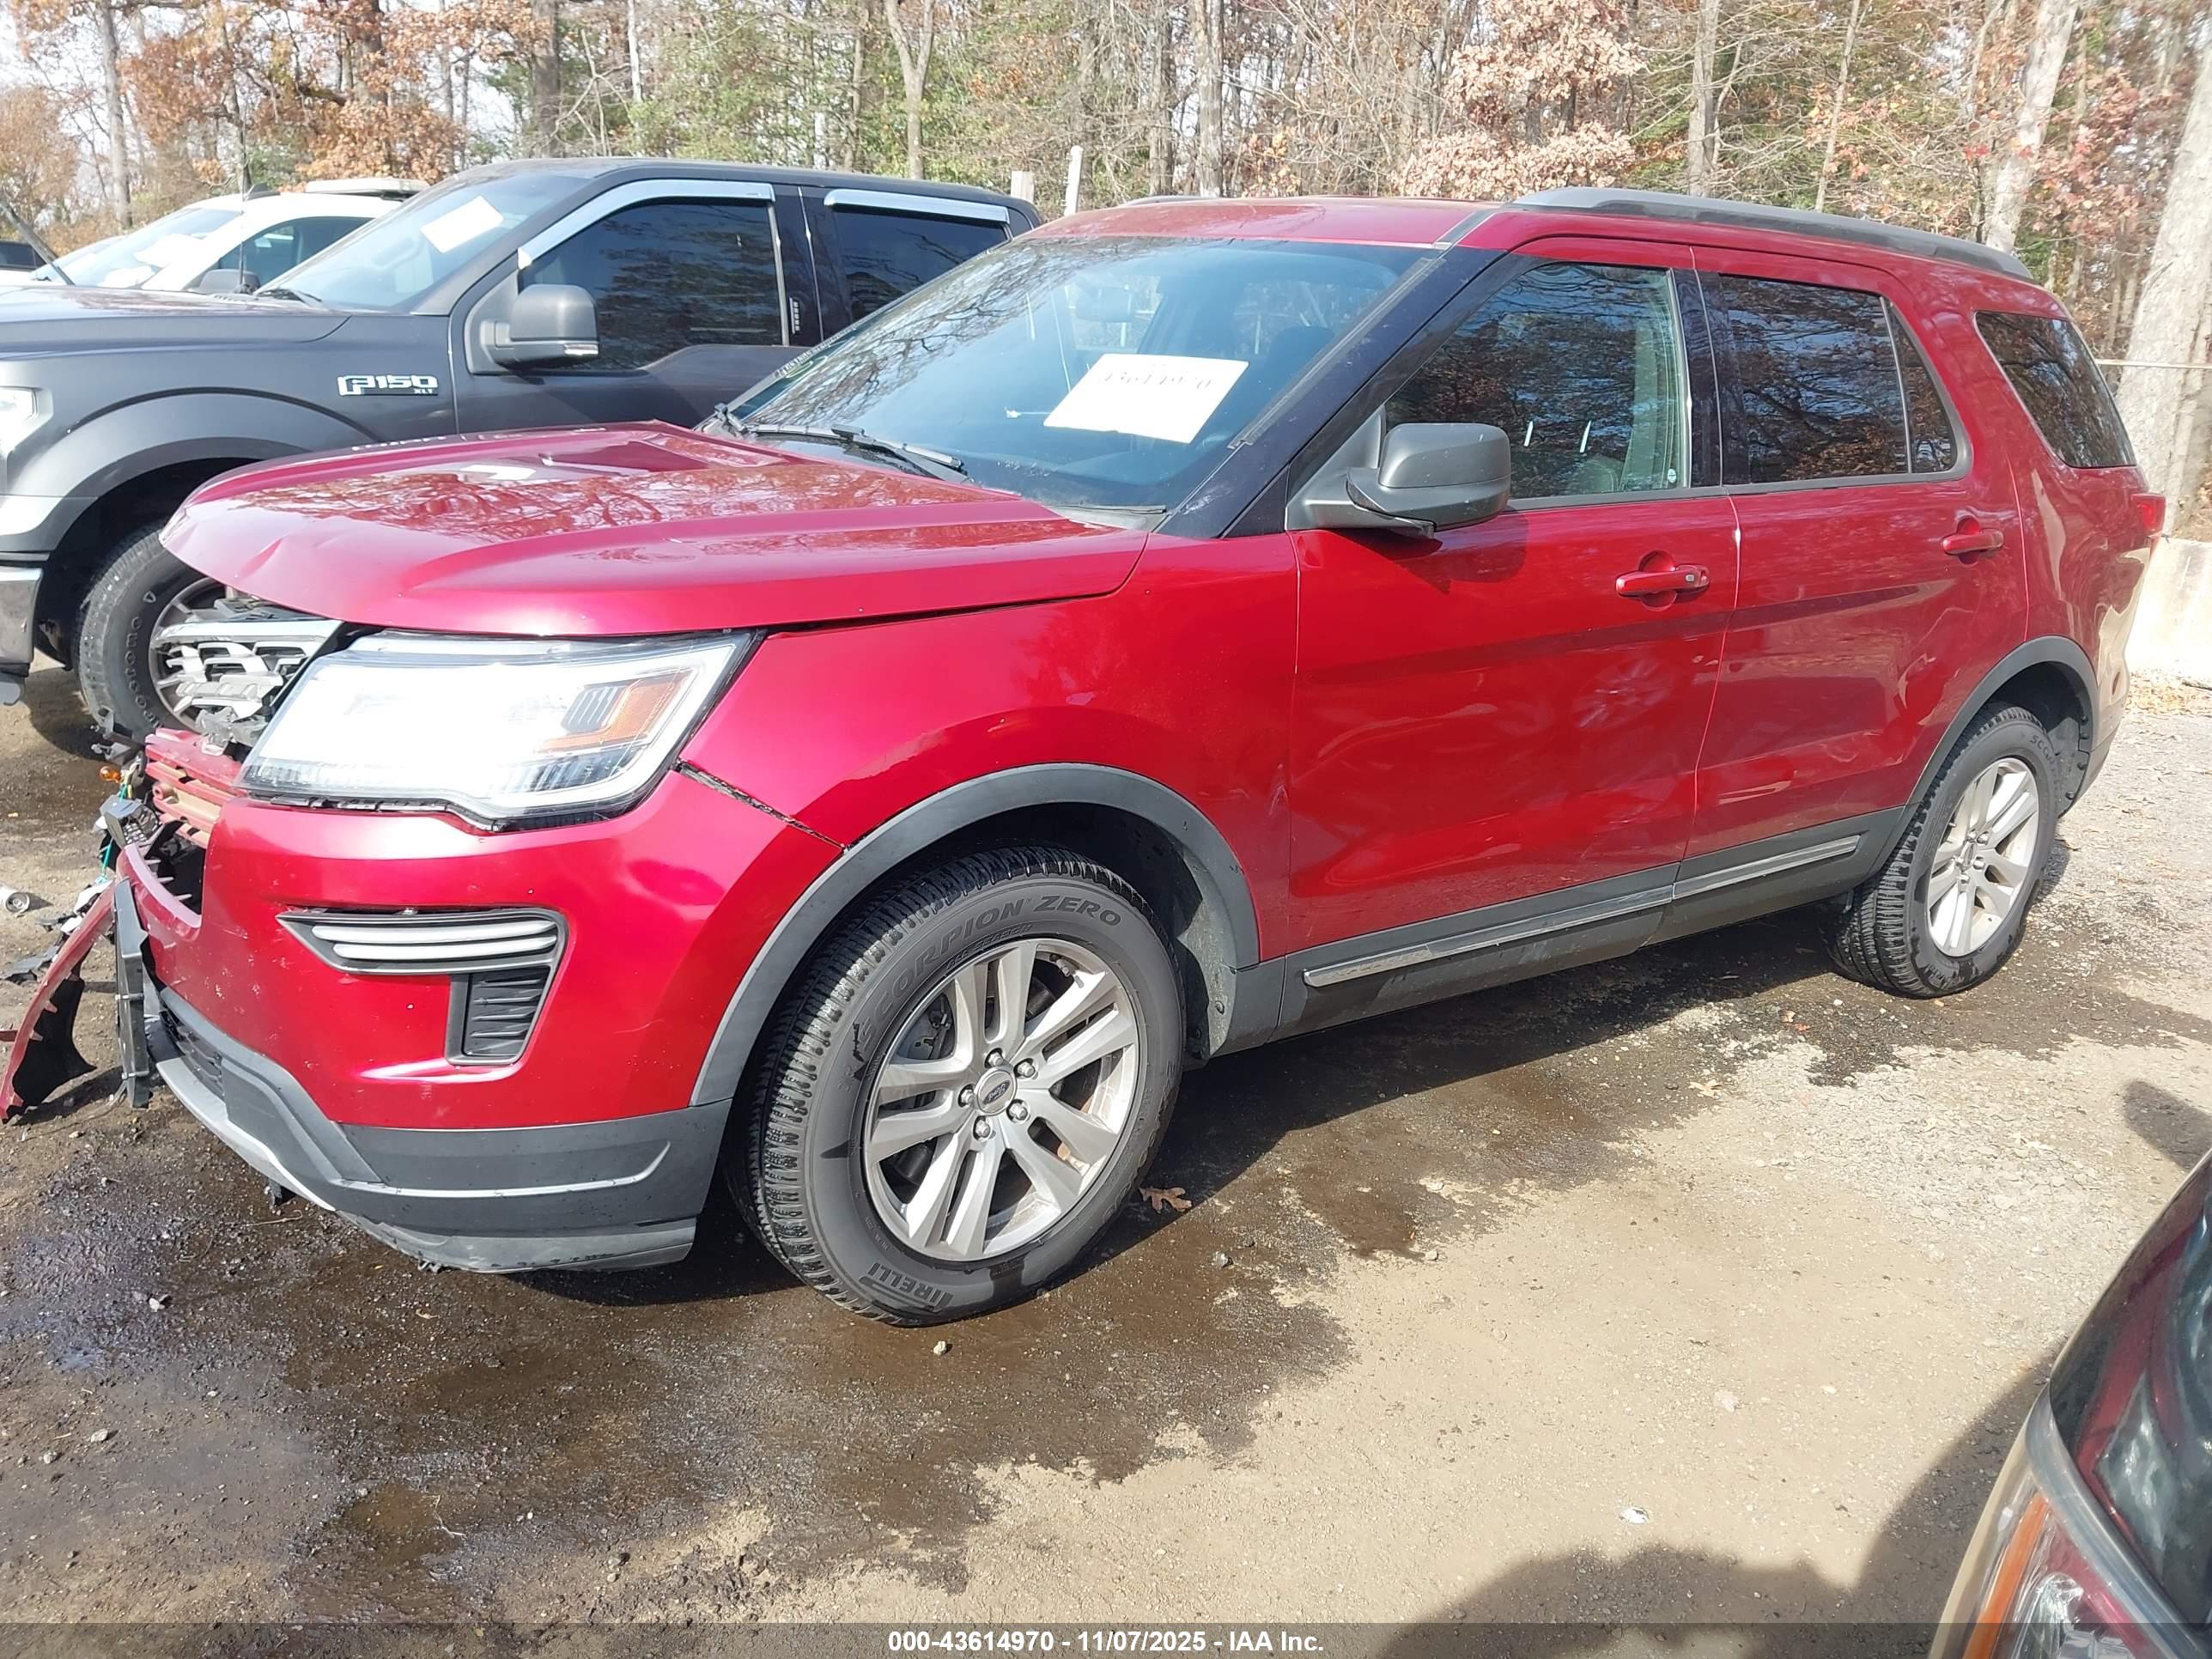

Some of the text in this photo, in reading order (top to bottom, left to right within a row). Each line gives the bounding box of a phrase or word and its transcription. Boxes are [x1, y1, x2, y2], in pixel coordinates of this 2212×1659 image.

[857, 895, 1122, 1051] SCORPION ZERO
[988, 1083, 1006, 1101] Ford
[859, 1261, 954, 1312] PIRELLI
